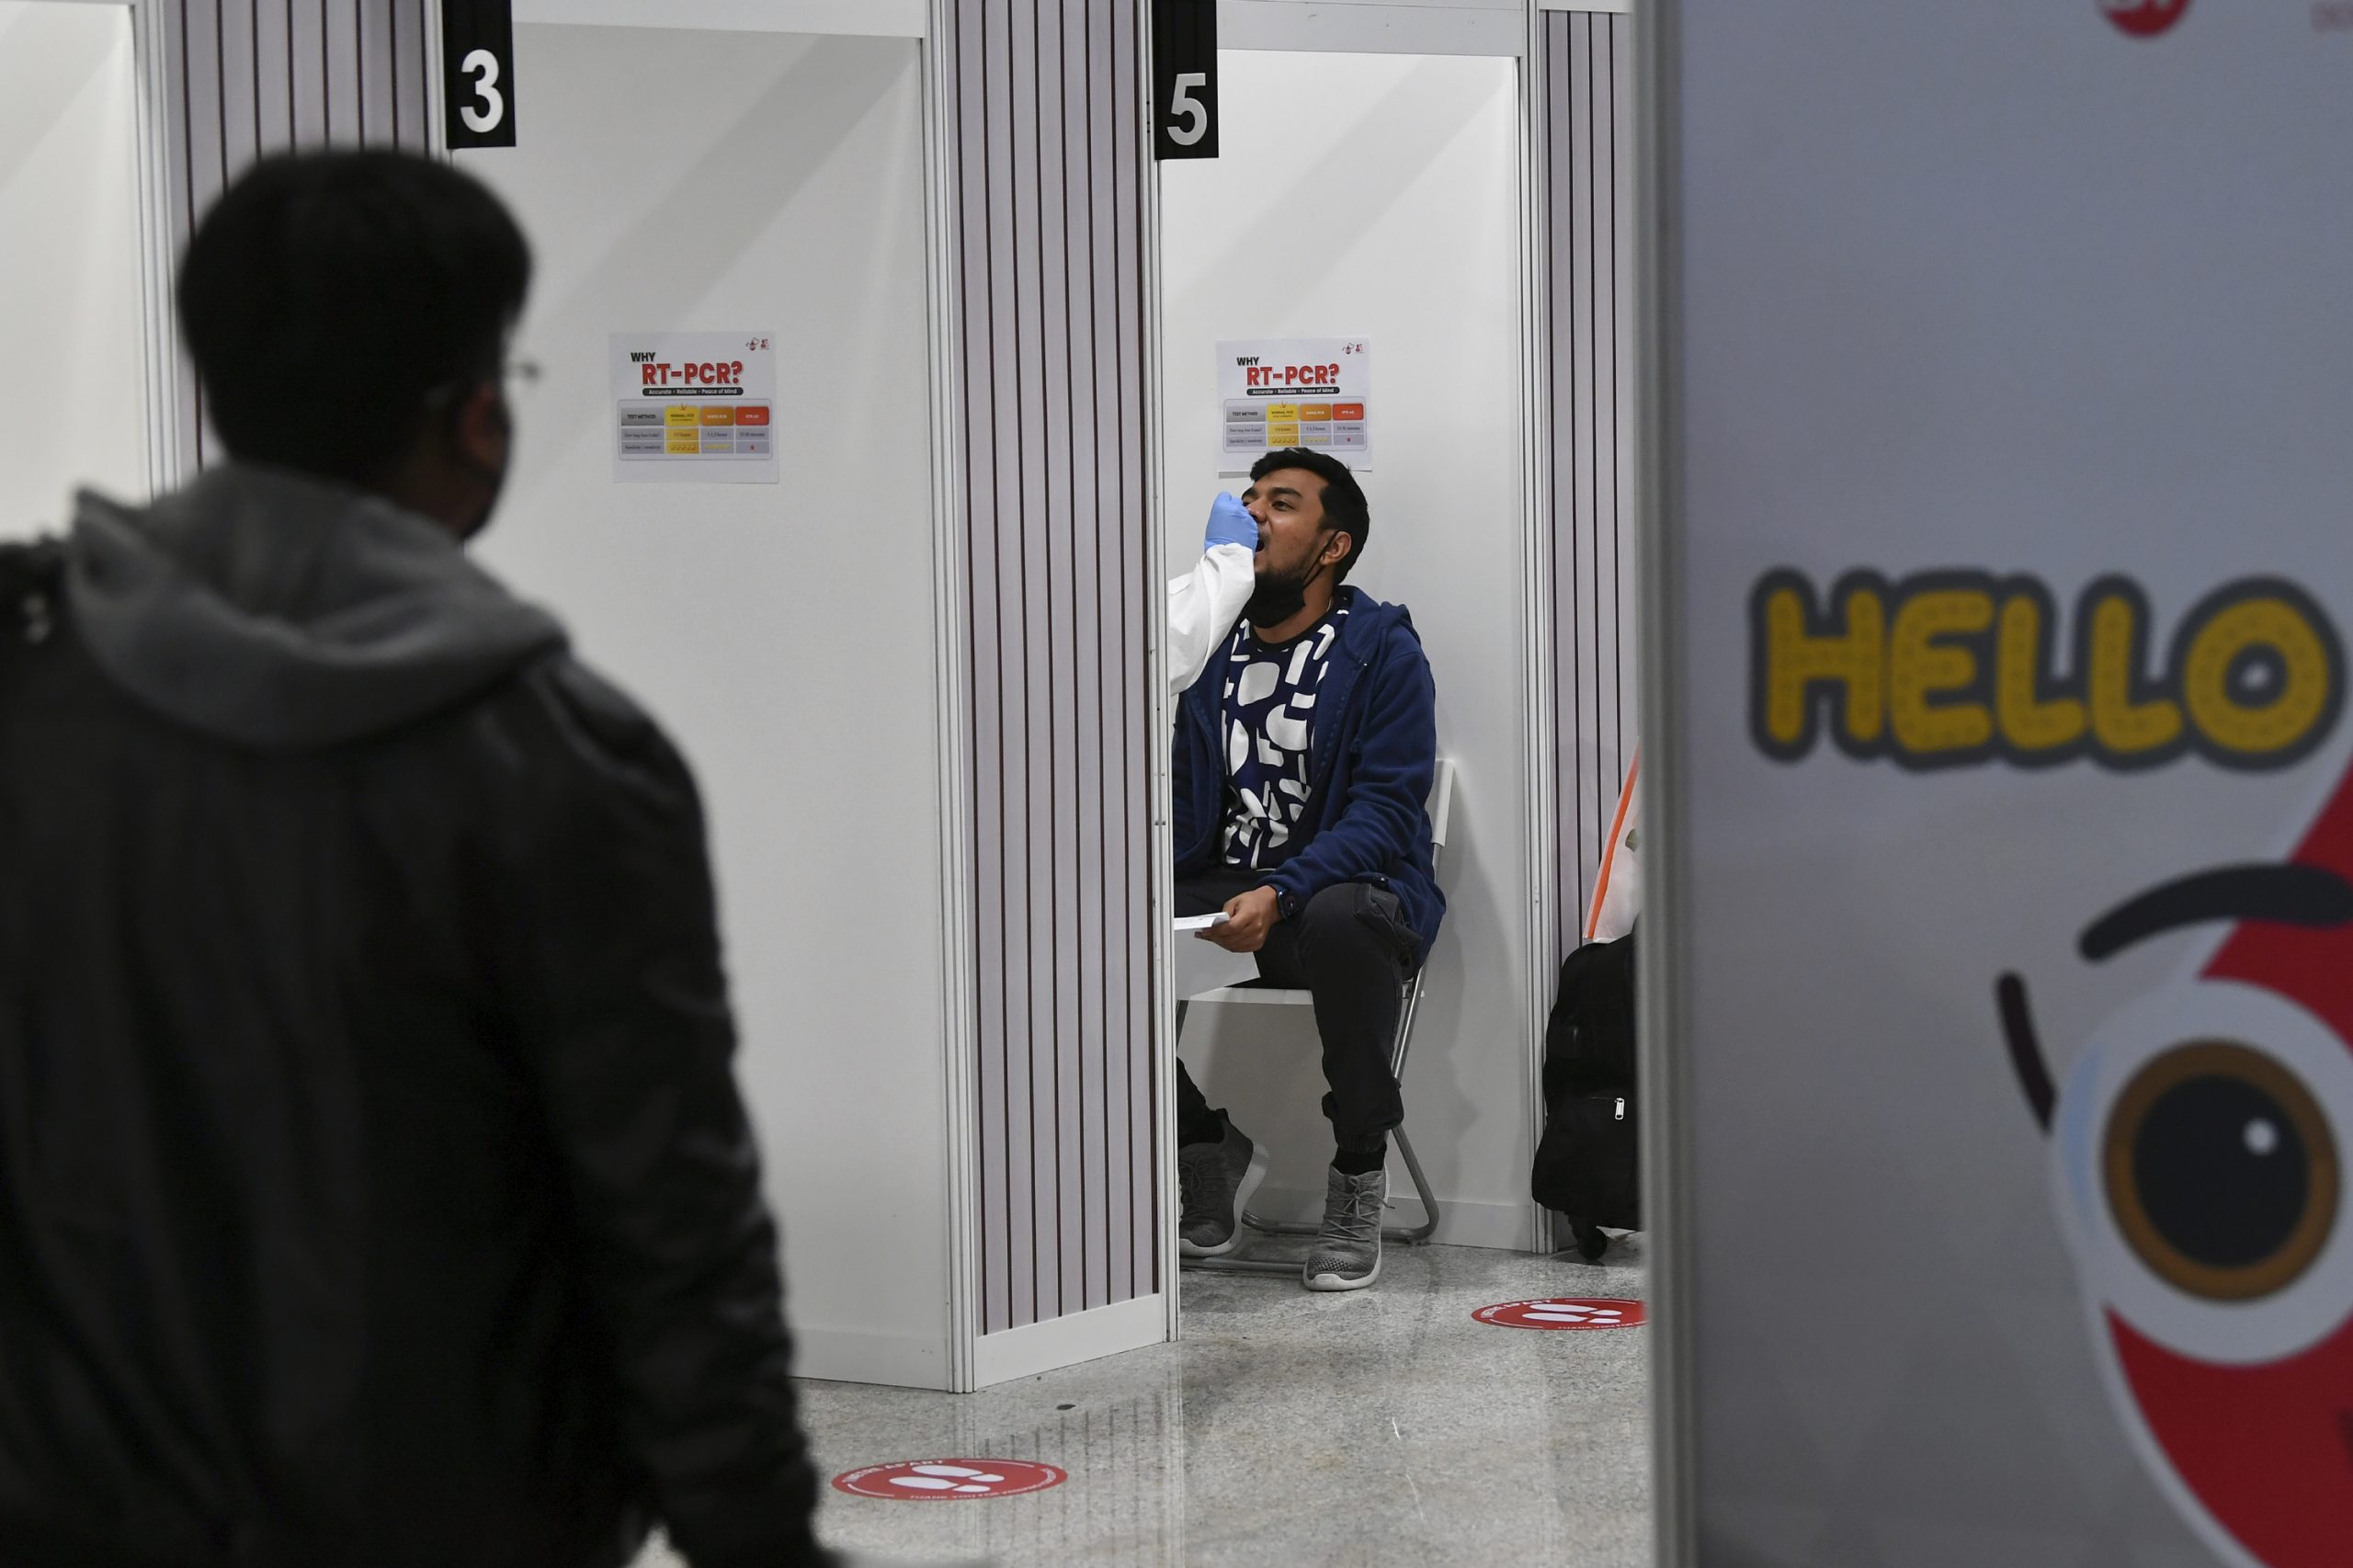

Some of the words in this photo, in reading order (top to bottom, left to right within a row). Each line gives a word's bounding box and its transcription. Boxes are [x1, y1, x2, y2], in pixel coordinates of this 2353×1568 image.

[460, 49, 504, 133] 3
[1166, 73, 1208, 146] 5
[631, 352, 656, 362] WHY
[1236, 357, 1260, 366] WHY
[642, 360, 745, 386] RT-PCR?
[1246, 363, 1340, 386] RT-PCR?
[1750, 566, 2347, 774] HELLO
